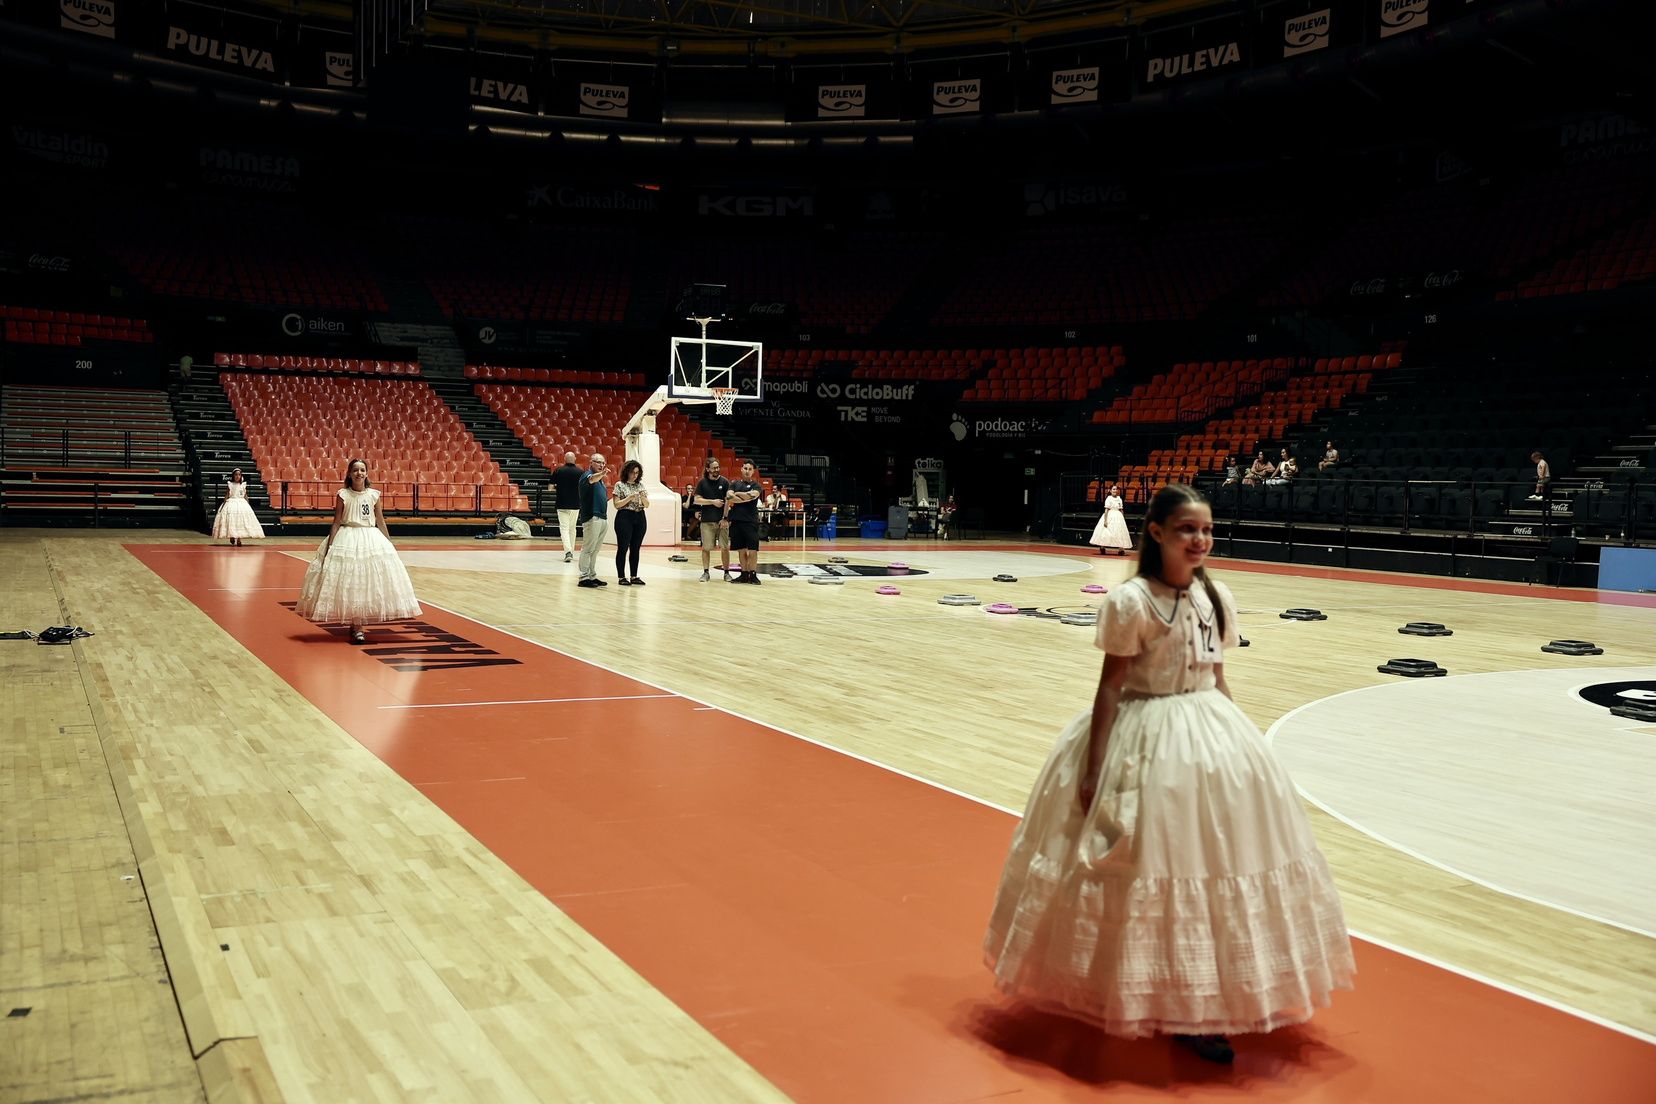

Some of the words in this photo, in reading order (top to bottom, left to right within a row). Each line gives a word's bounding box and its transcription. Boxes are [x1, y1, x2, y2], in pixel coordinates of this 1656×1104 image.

[1287, 16, 1327, 35] PULEVA
[166, 25, 275, 73] PULEVA
[329, 56, 352, 67] PUL
[1147, 42, 1240, 83] PULEVA
[1055, 73, 1096, 85] PULEVA
[469, 77, 529, 104] LEVA
[583, 87, 627, 100] PULEVA
[821, 90, 863, 99] PULEVA
[936, 84, 978, 95] PULEVA
[699, 196, 814, 216] KGM
[309, 317, 345, 331] aiken
[75, 360, 93, 369] 200
[845, 384, 915, 400] CicloBuff
[837, 406, 868, 422] TKE
